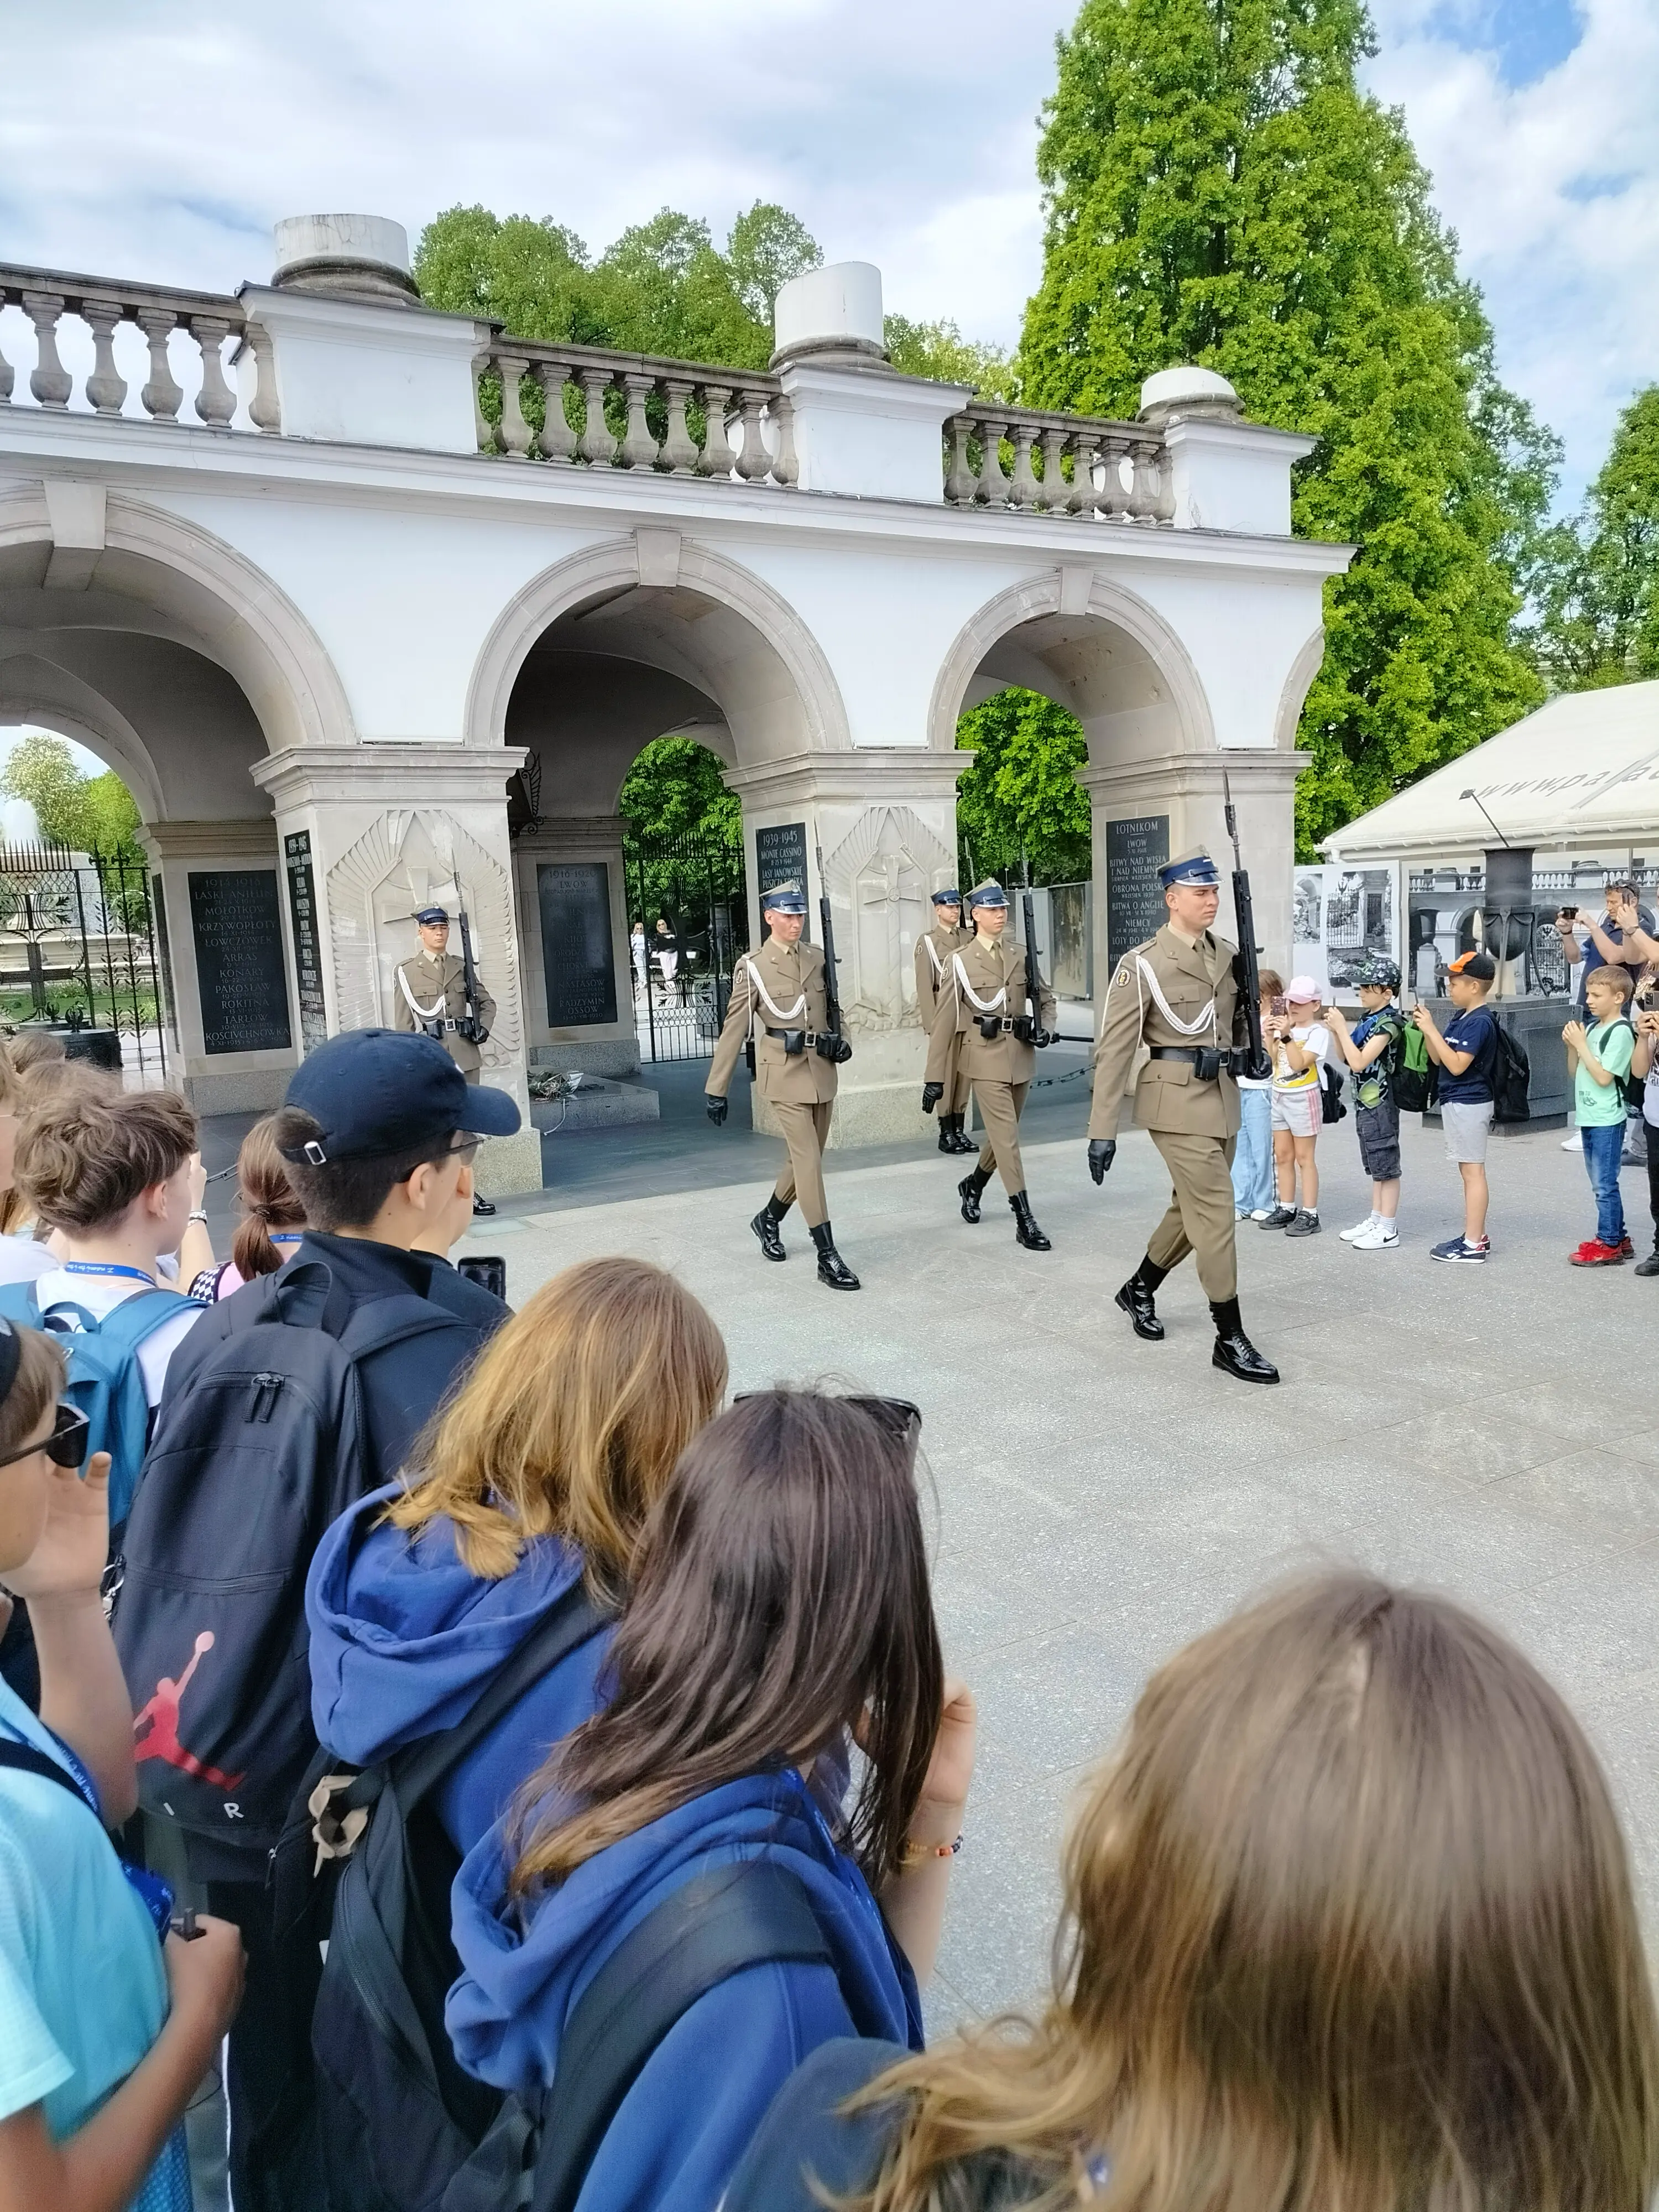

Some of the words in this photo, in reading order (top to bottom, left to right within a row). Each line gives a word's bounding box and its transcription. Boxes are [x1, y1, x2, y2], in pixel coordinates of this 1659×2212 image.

[1117, 820, 1157, 834] LOTNIKOM
[764, 830, 797, 847] 1939-1945
[761, 849, 778, 860] MONTE
[779, 846, 801, 858] CASSINO
[1109, 858, 1127, 867] BITWY
[1130, 857, 1143, 865] NAD
[763, 869, 773, 879] LASY
[1117, 867, 1129, 875] NAD
[1112, 883, 1139, 894] OBRONA
[1112, 901, 1130, 911] BITWA
[1133, 901, 1138, 909] O
[1125, 917, 1150, 928] NIEMCY
[1112, 936, 1126, 945] LOTY
[1129, 936, 1139, 945] DO
[222, 952, 257, 962] ARRAS
[220, 967, 265, 978] KONARY
[221, 997, 269, 1009] ROKITNA
[559, 997, 604, 1008] RADZYMIN
